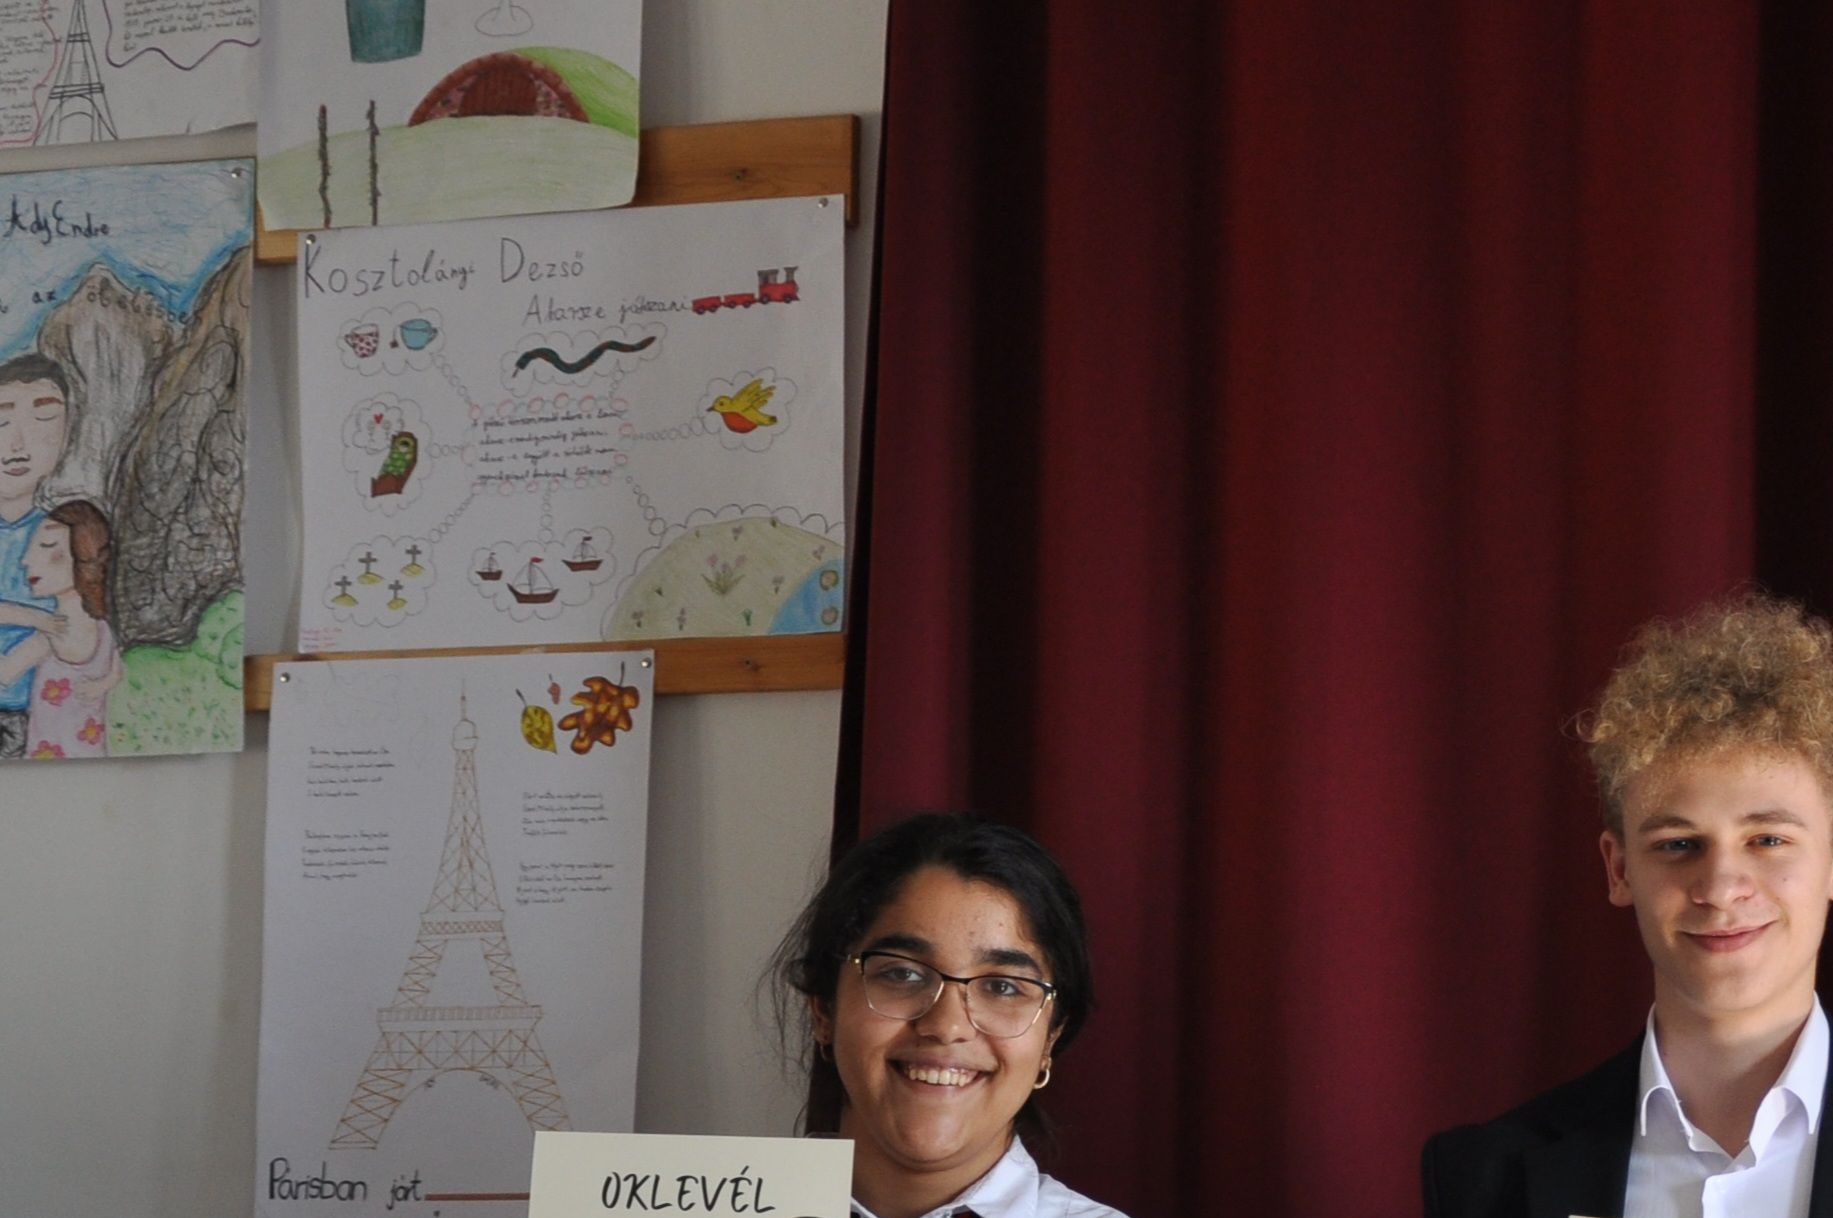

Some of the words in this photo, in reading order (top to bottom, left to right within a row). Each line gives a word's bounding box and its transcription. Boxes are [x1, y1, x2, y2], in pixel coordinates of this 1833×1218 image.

[52, 200, 110, 238] Endre
[303, 243, 476, 298] Kosztolányi
[500, 236, 584, 284] Dezső
[601, 1165, 776, 1213] OKLEVÉL
